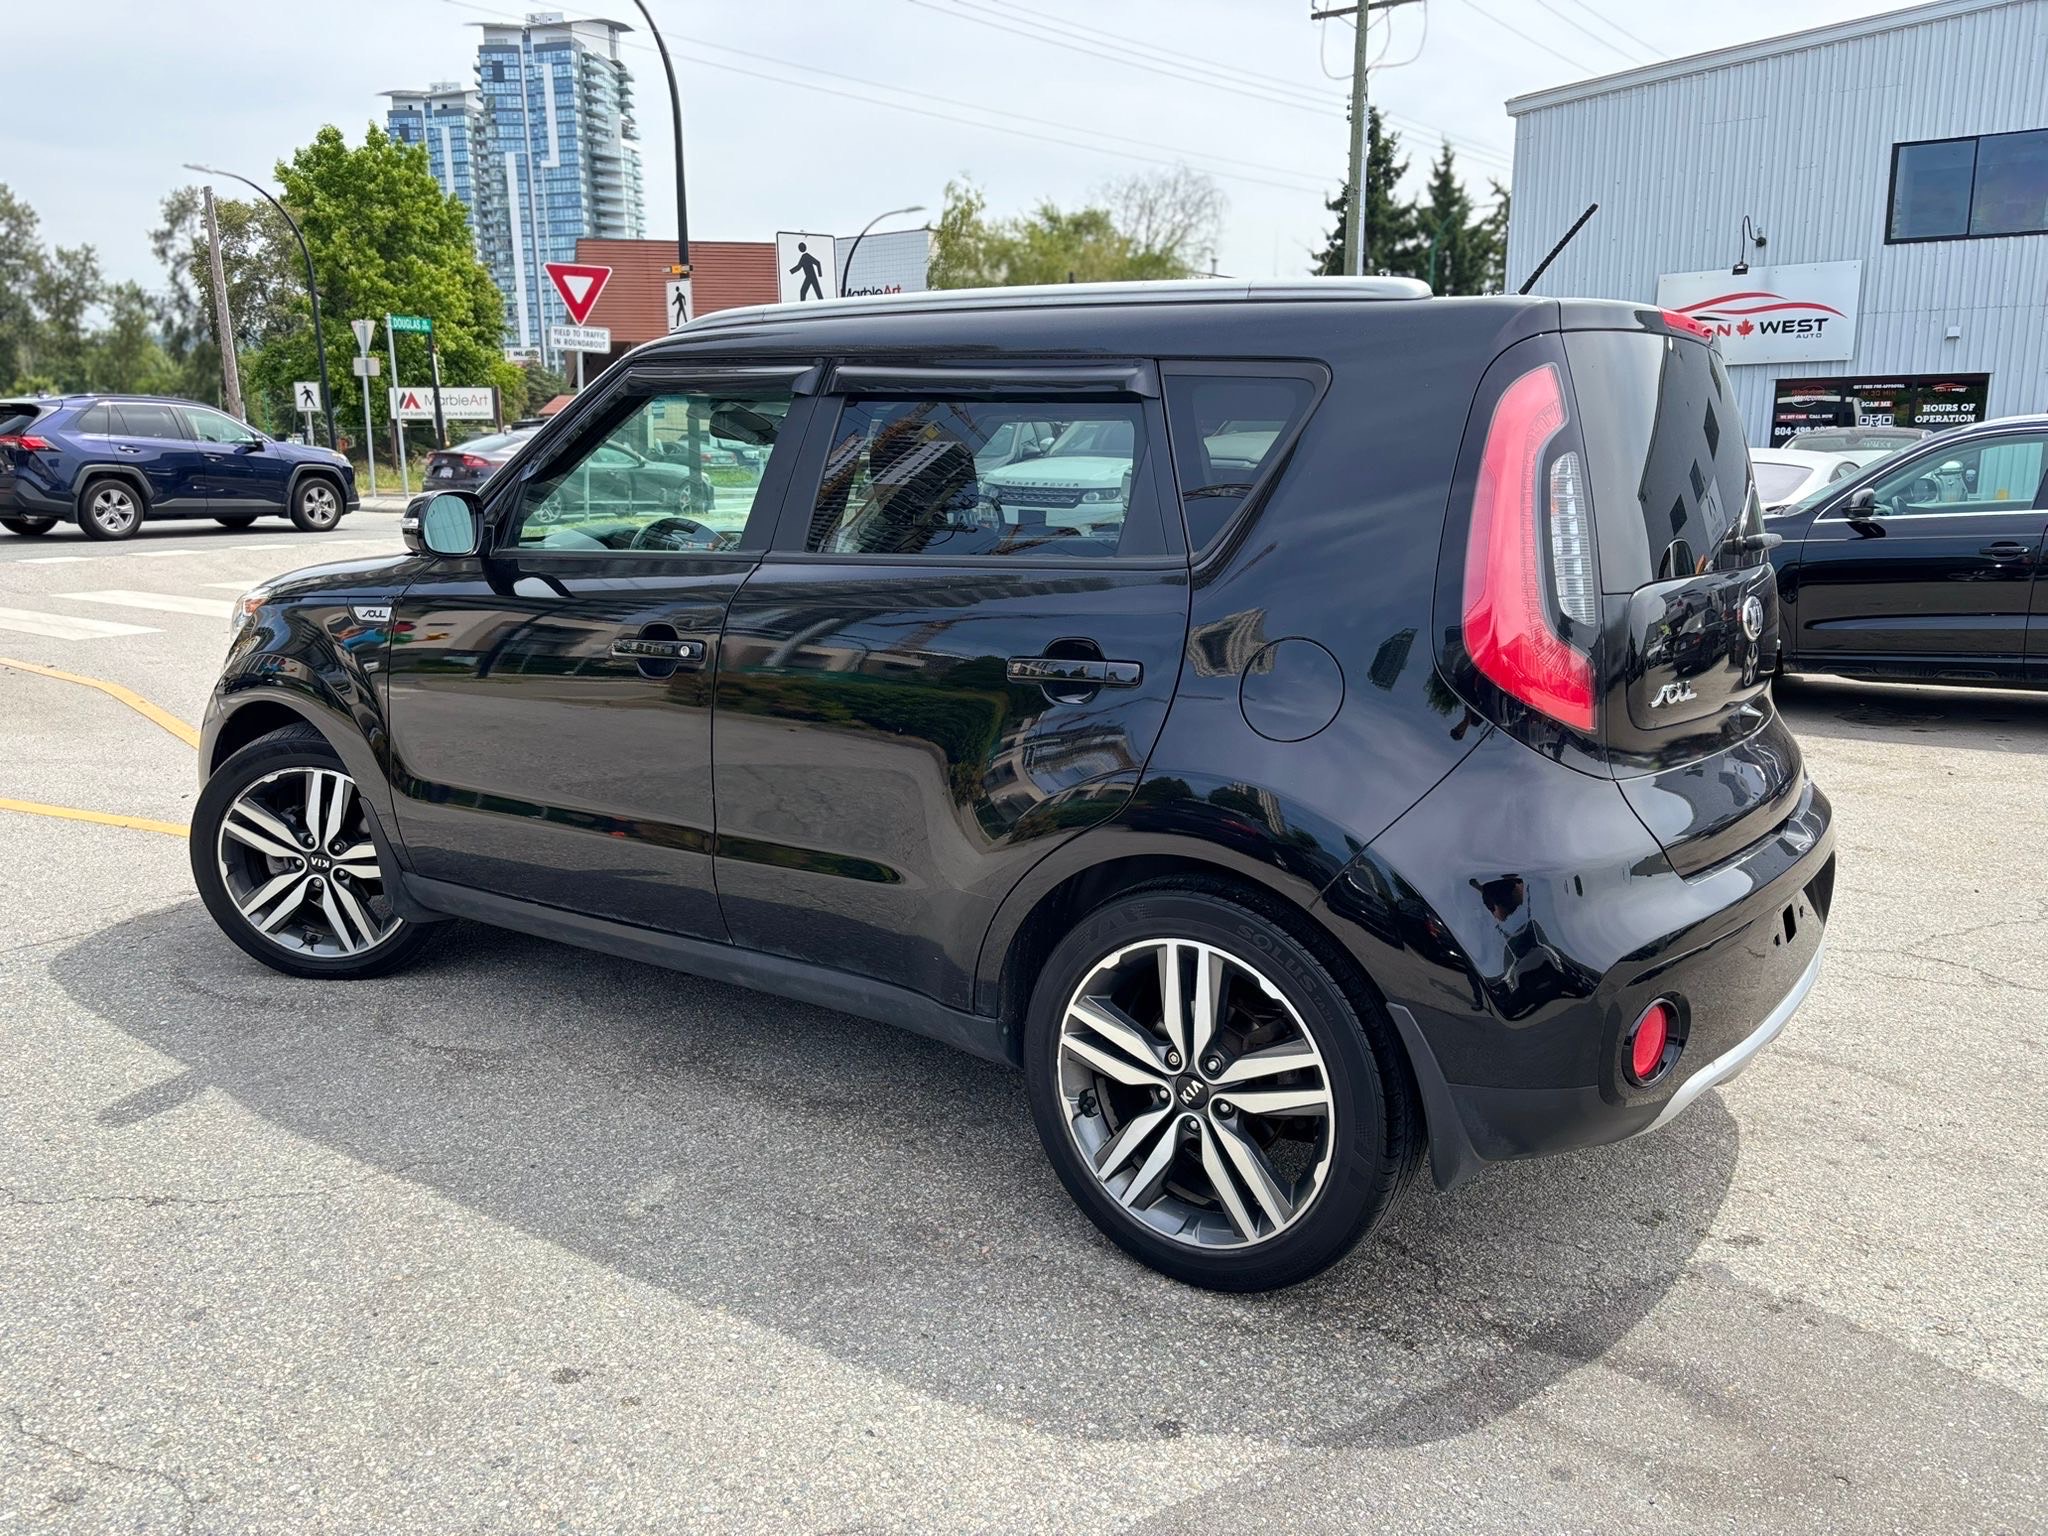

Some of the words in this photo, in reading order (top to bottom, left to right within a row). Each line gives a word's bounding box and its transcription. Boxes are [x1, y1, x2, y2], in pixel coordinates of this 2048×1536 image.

[393, 317, 420, 329] DOUGLAS
[1760, 318, 1829, 334] WEST
[553, 328, 570, 337] YIELD
[583, 329, 606, 339] TRAFFIC
[563, 339, 607, 349] ROUNDABOUT
[1922, 404, 1958, 413] HOURS
[1961, 403, 1976, 411] OF
[1915, 414, 1976, 423] OPERATION
[310, 856, 330, 868] KIA
[1236, 925, 1318, 993] SOLUS
[1180, 1080, 1204, 1104] KIA
